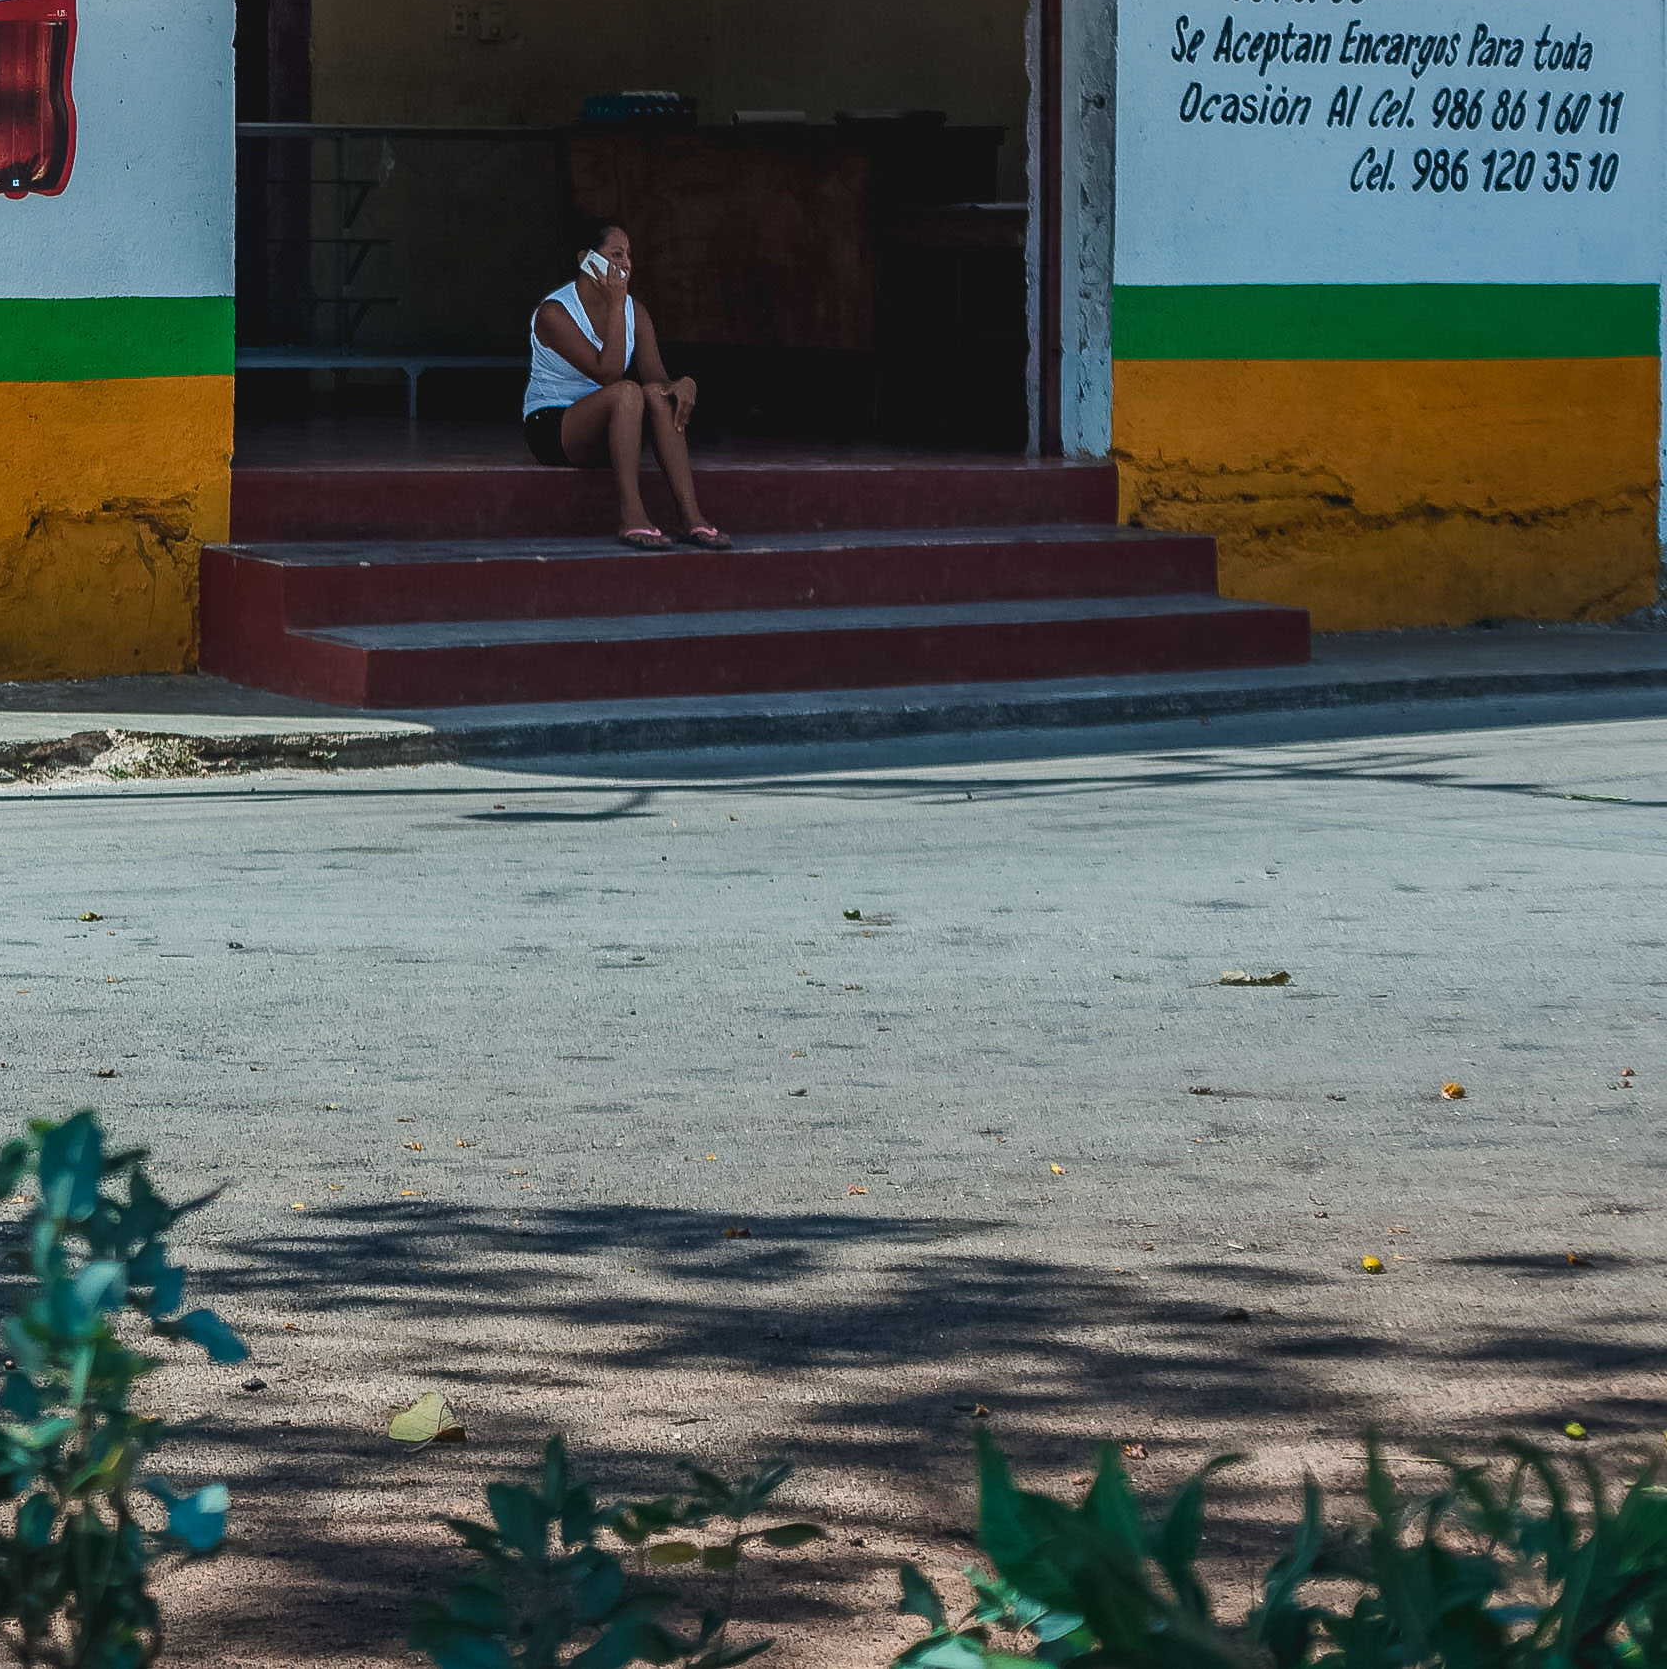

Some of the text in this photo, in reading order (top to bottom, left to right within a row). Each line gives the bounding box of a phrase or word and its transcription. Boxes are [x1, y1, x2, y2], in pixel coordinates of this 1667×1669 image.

[1170, 14, 1593, 80] Se Aceptan Encargos Para toda
[1326, 85, 1363, 128] Al
[1368, 86, 1415, 128] Cel.
[1432, 87, 1486, 131] 986
[1350, 146, 1396, 193] Cel.
[1411, 148, 1469, 193] 986
[1481, 149, 1536, 193] 120
